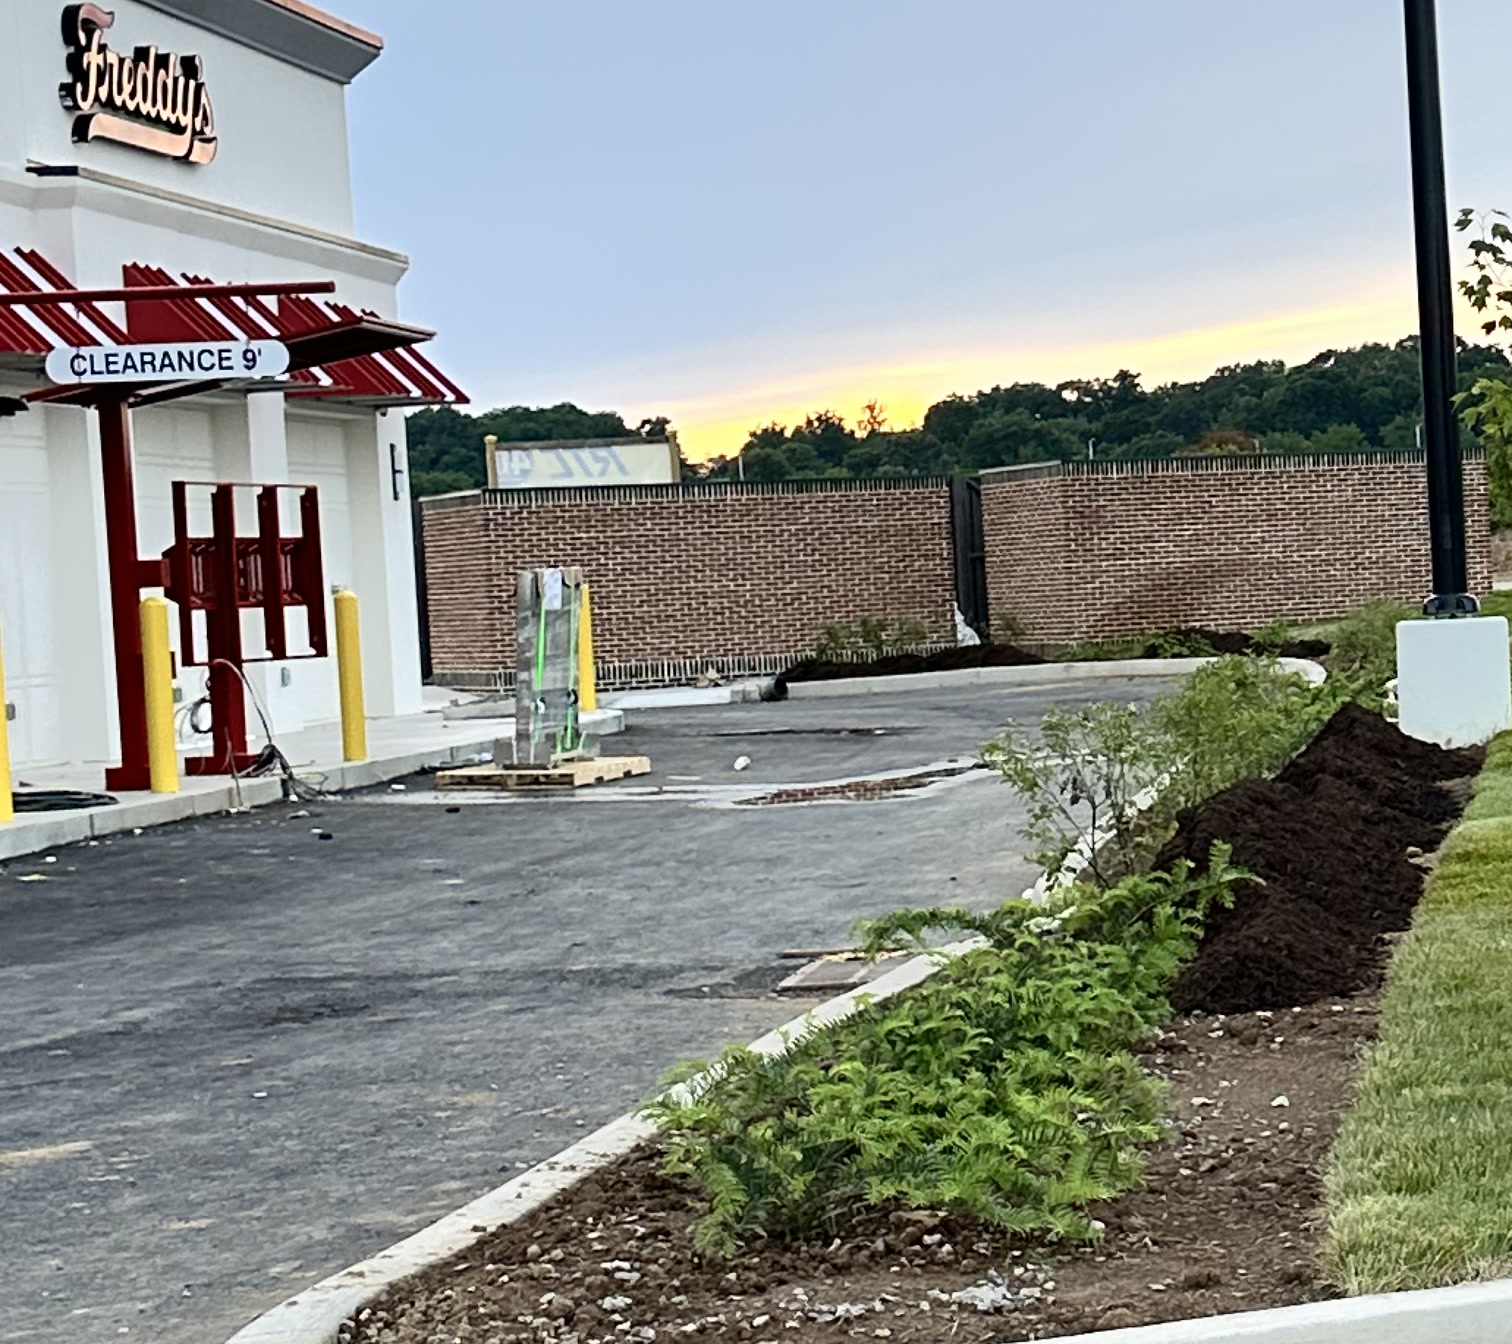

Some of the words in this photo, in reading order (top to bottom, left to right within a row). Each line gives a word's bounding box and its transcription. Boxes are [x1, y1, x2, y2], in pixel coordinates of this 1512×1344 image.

[66, 3, 217, 163] Freddy's
[69, 348, 234, 377] CLEARANCE
[241, 347, 262, 371] 9'
